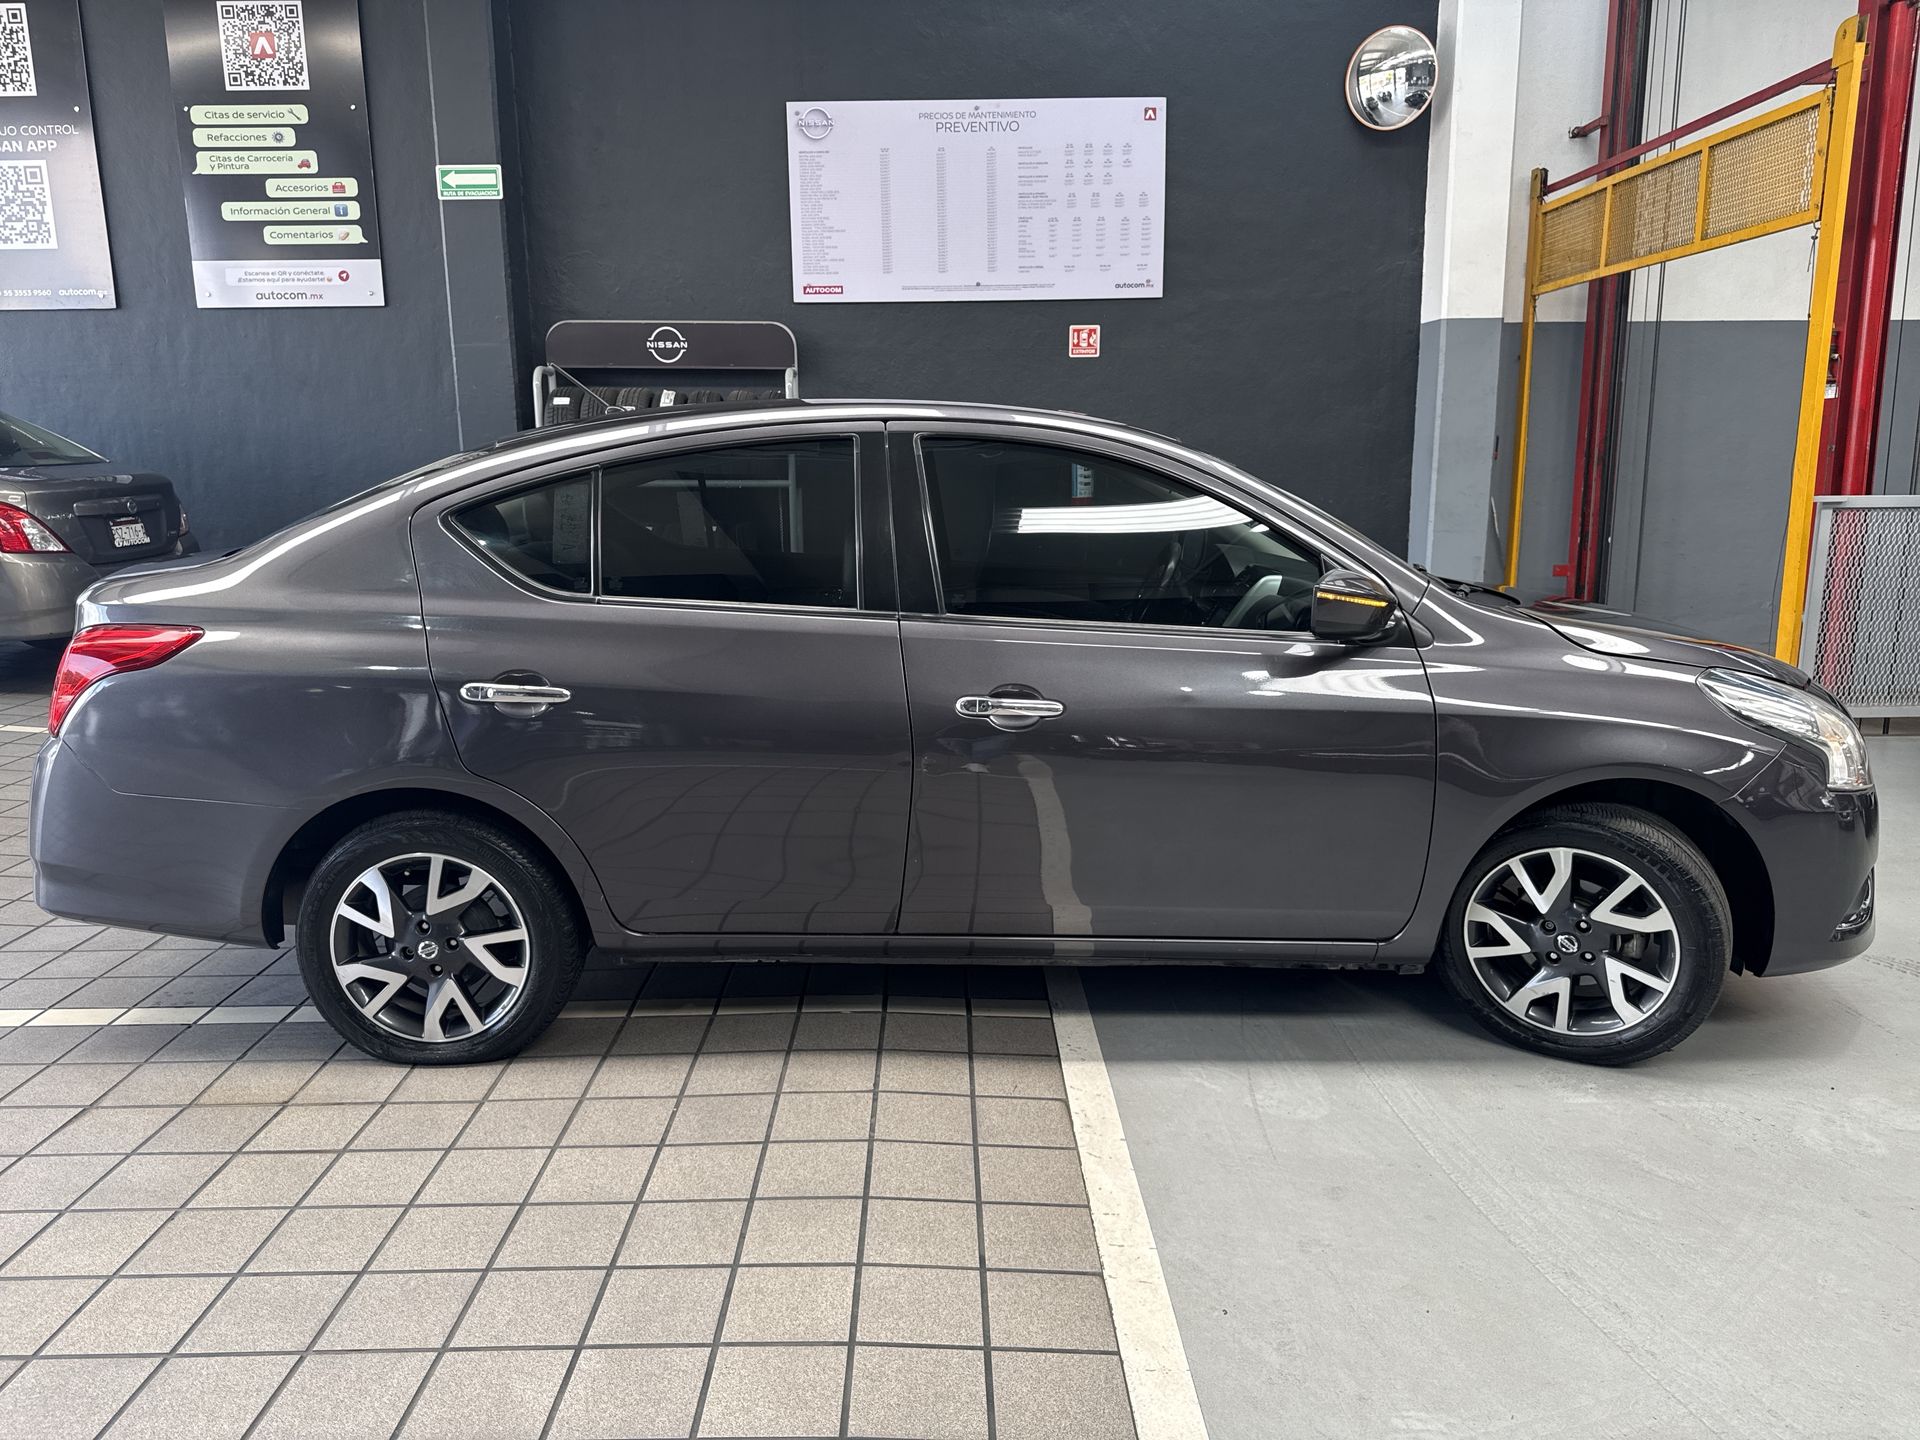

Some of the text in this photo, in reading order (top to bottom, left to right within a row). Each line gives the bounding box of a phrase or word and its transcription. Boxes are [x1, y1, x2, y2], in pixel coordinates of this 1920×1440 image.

[204, 110, 285, 119] Citas de servicio
[918, 110, 1037, 120] PRECIOS DE MANTENIMIENTO
[20, 124, 79, 136] CONTROL
[935, 120, 1020, 133] PREVENTIVO
[207, 133, 267, 142] Refacciones
[0, 139, 57, 153] AN APP
[233, 154, 245, 162] de
[210, 162, 250, 171] y Pintura
[275, 184, 329, 192] Accesorios
[230, 207, 331, 216] Información General
[269, 231, 334, 240] Comentarios
[3, 289, 13, 297] 55
[256, 290, 324, 300] autocom.mx
